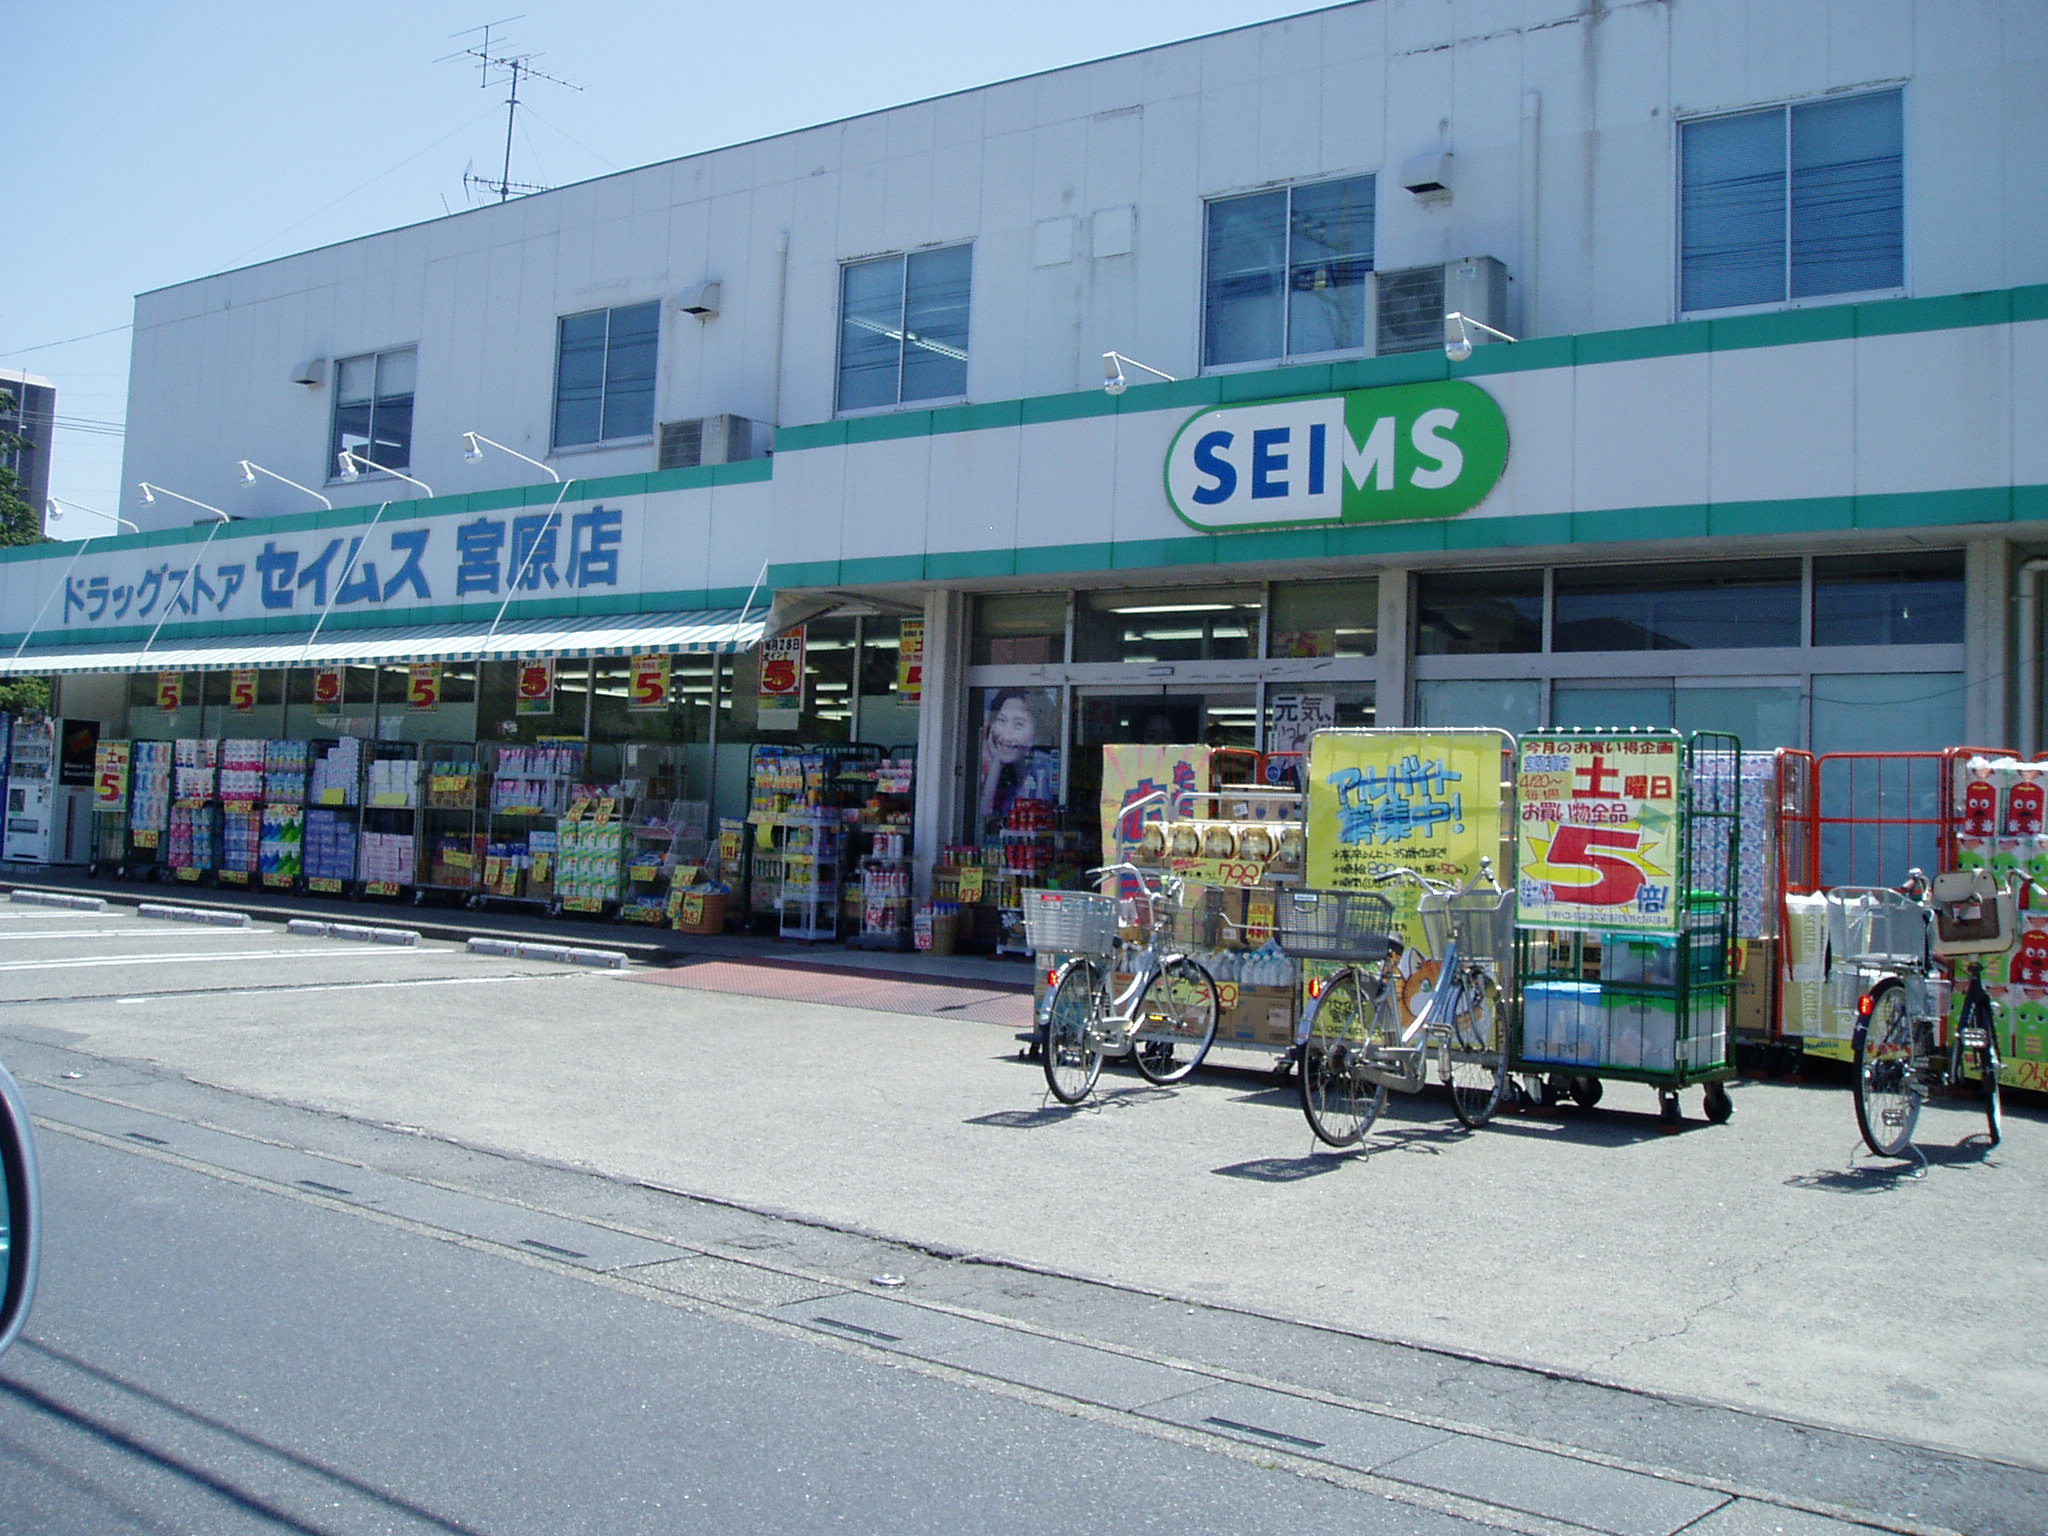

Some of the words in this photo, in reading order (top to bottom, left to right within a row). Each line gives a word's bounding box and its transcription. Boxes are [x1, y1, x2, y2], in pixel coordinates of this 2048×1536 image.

[1192, 407, 1464, 505] SEIMS
[63, 563, 246, 624] ドラッグストア
[256, 528, 432, 610] セイムス
[456, 505, 623, 597] 宮原店
[316, 674, 338, 699] 5
[412, 678, 436, 707] 5
[520, 667, 547, 696] 5
[636, 672, 664, 704] 5
[161, 685, 179, 710] 5
[235, 683, 253, 710] 5
[1525, 741, 1674, 755] 今月のお買い得企画
[101, 774, 120, 801] 5
[1327, 754, 1462, 804] アルバイト
[1572, 756, 1672, 800] 土曜日
[1218, 862, 1260, 885] 798
